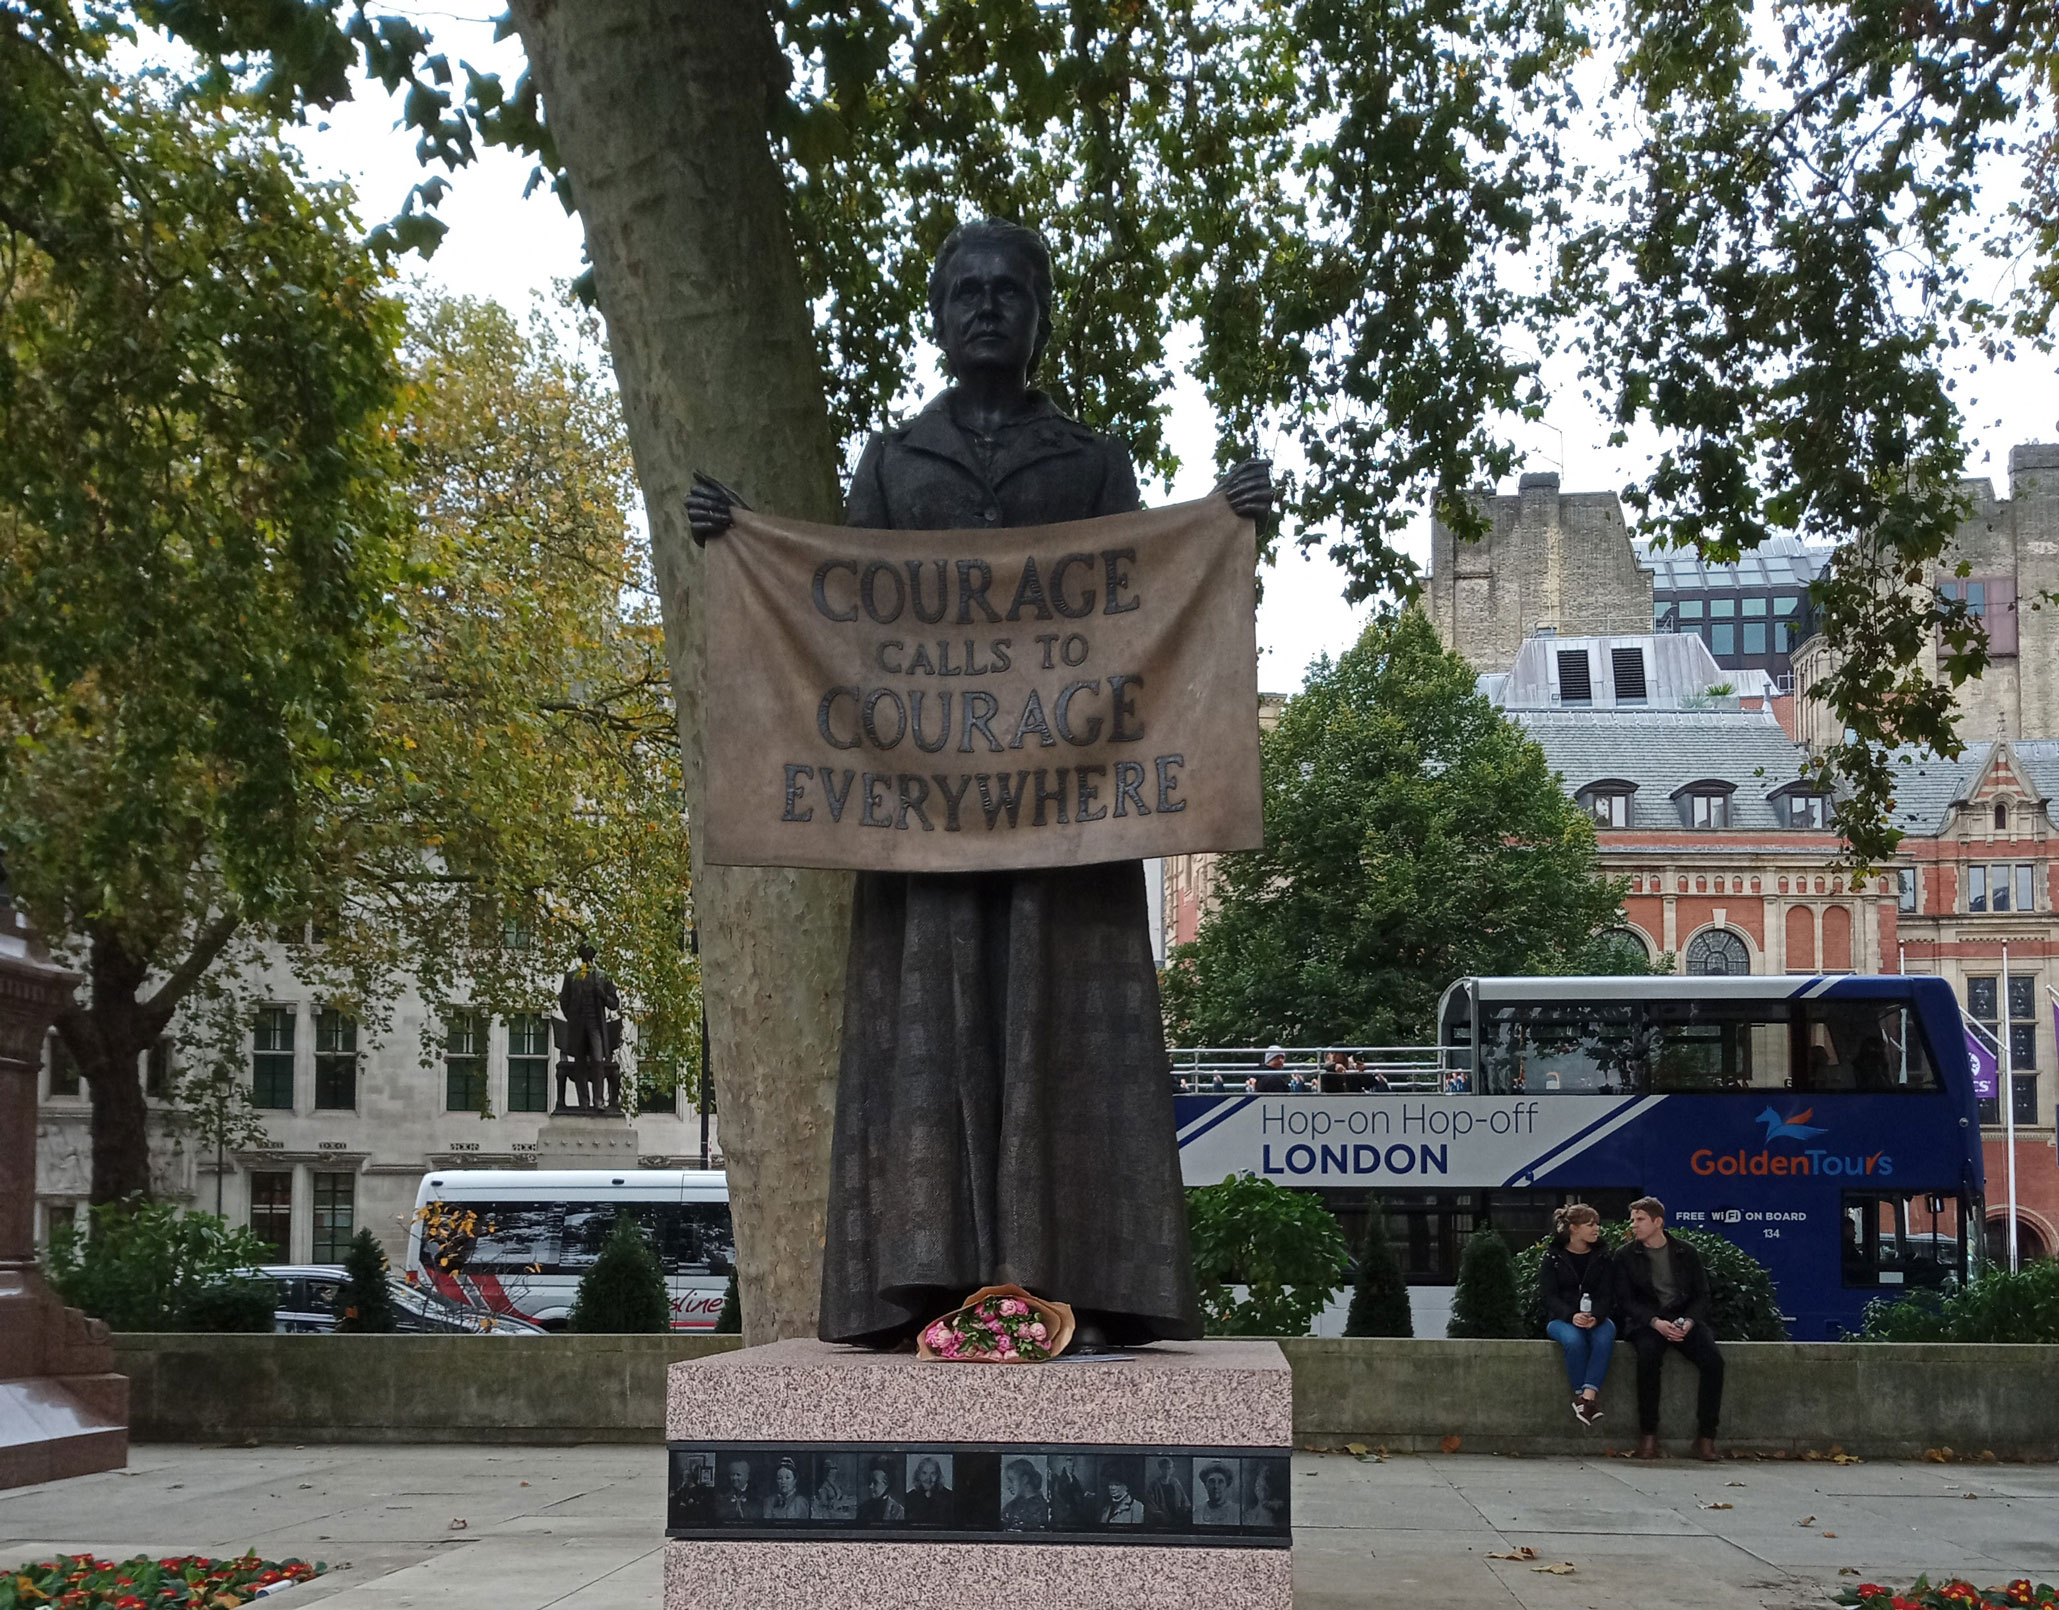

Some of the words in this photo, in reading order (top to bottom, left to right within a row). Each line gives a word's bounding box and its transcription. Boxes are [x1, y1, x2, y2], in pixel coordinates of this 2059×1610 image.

[813, 549, 1140, 624] COURAGE
[876, 639, 1011, 675] CALLS
[1036, 632, 1090, 669] TO
[817, 674, 1145, 754] COURAGE
[782, 755, 1187, 832] EVERYWHERE
[1262, 1104, 1390, 1140] Hop-on
[1402, 1102, 1539, 1140] Hop-off
[1262, 1144, 1448, 1175] LONDON
[1690, 1149, 1893, 1175] GoldenTours
[1675, 1211, 1705, 1221] FREE
[1745, 1212, 1763, 1221] ON
[1765, 1212, 1807, 1221] BOARD
[1762, 1229, 1780, 1239] 134
[669, 1288, 724, 1314] sline
